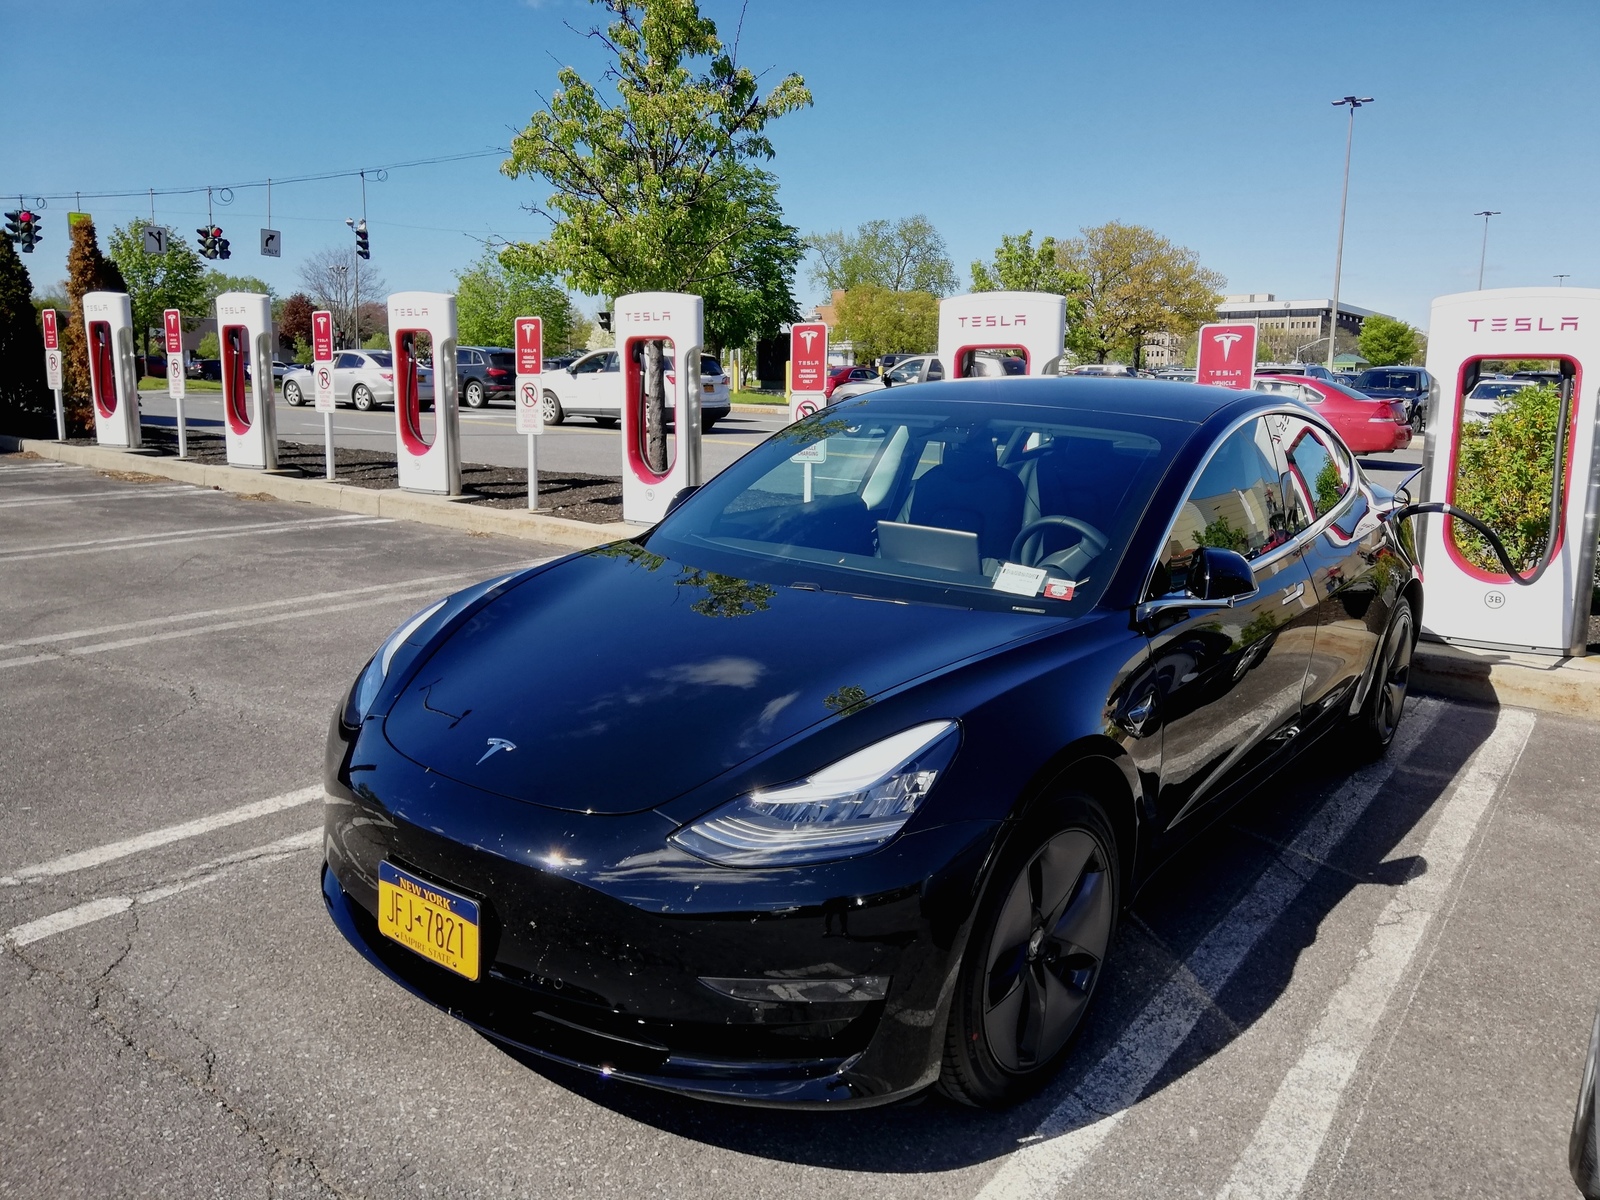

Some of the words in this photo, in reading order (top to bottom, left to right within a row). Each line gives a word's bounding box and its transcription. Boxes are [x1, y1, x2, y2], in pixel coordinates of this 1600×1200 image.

[221, 306, 246, 314] TESLA
[394, 308, 428, 316] TESLA
[625, 311, 671, 321] TESLA
[958, 314, 1026, 328] TESLA
[1467, 316, 1579, 332] TESLA
[1488, 595, 1502, 603] 3B
[399, 877, 422, 896] NEW
[423, 888, 451, 911] YORK
[425, 907, 464, 959] 7821
[400, 932, 426, 952] EMPIRE
[428, 947, 451, 965] STATE
